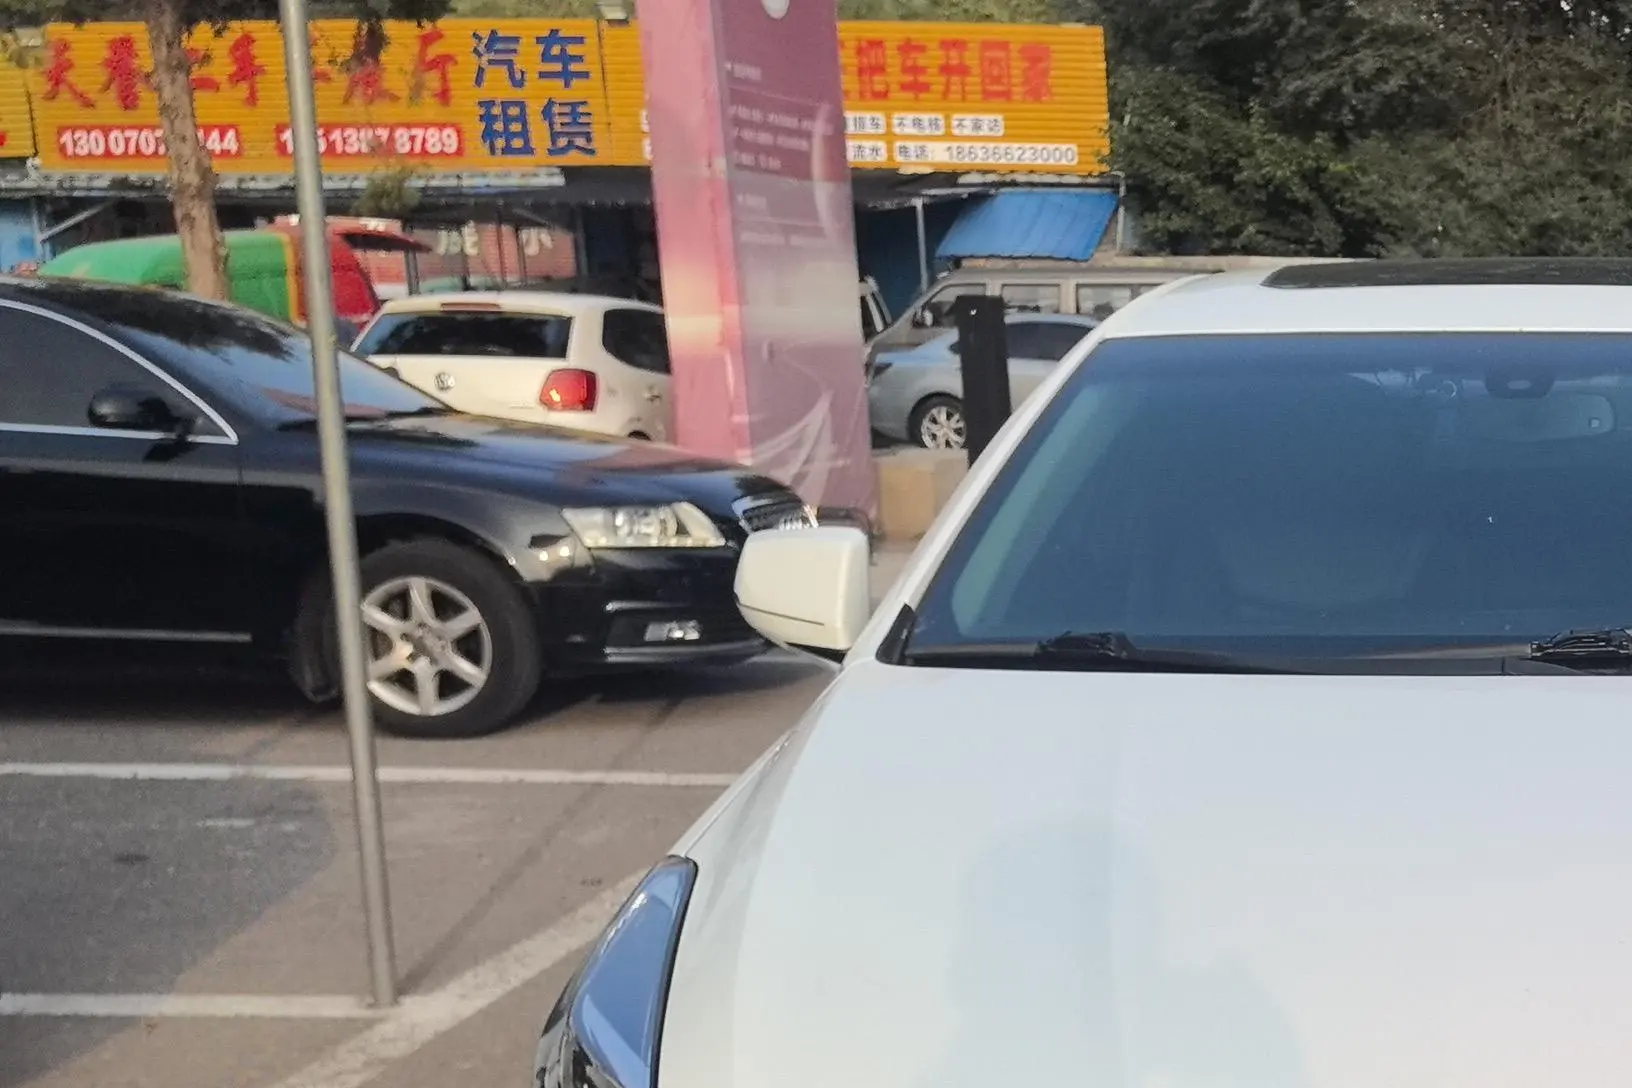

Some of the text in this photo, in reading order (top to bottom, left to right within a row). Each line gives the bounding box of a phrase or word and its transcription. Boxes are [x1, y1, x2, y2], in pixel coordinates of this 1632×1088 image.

[472, 29, 590, 88] 汽车
[842, 37, 1053, 103] 把车开回家
[479, 97, 596, 156] 租赁
